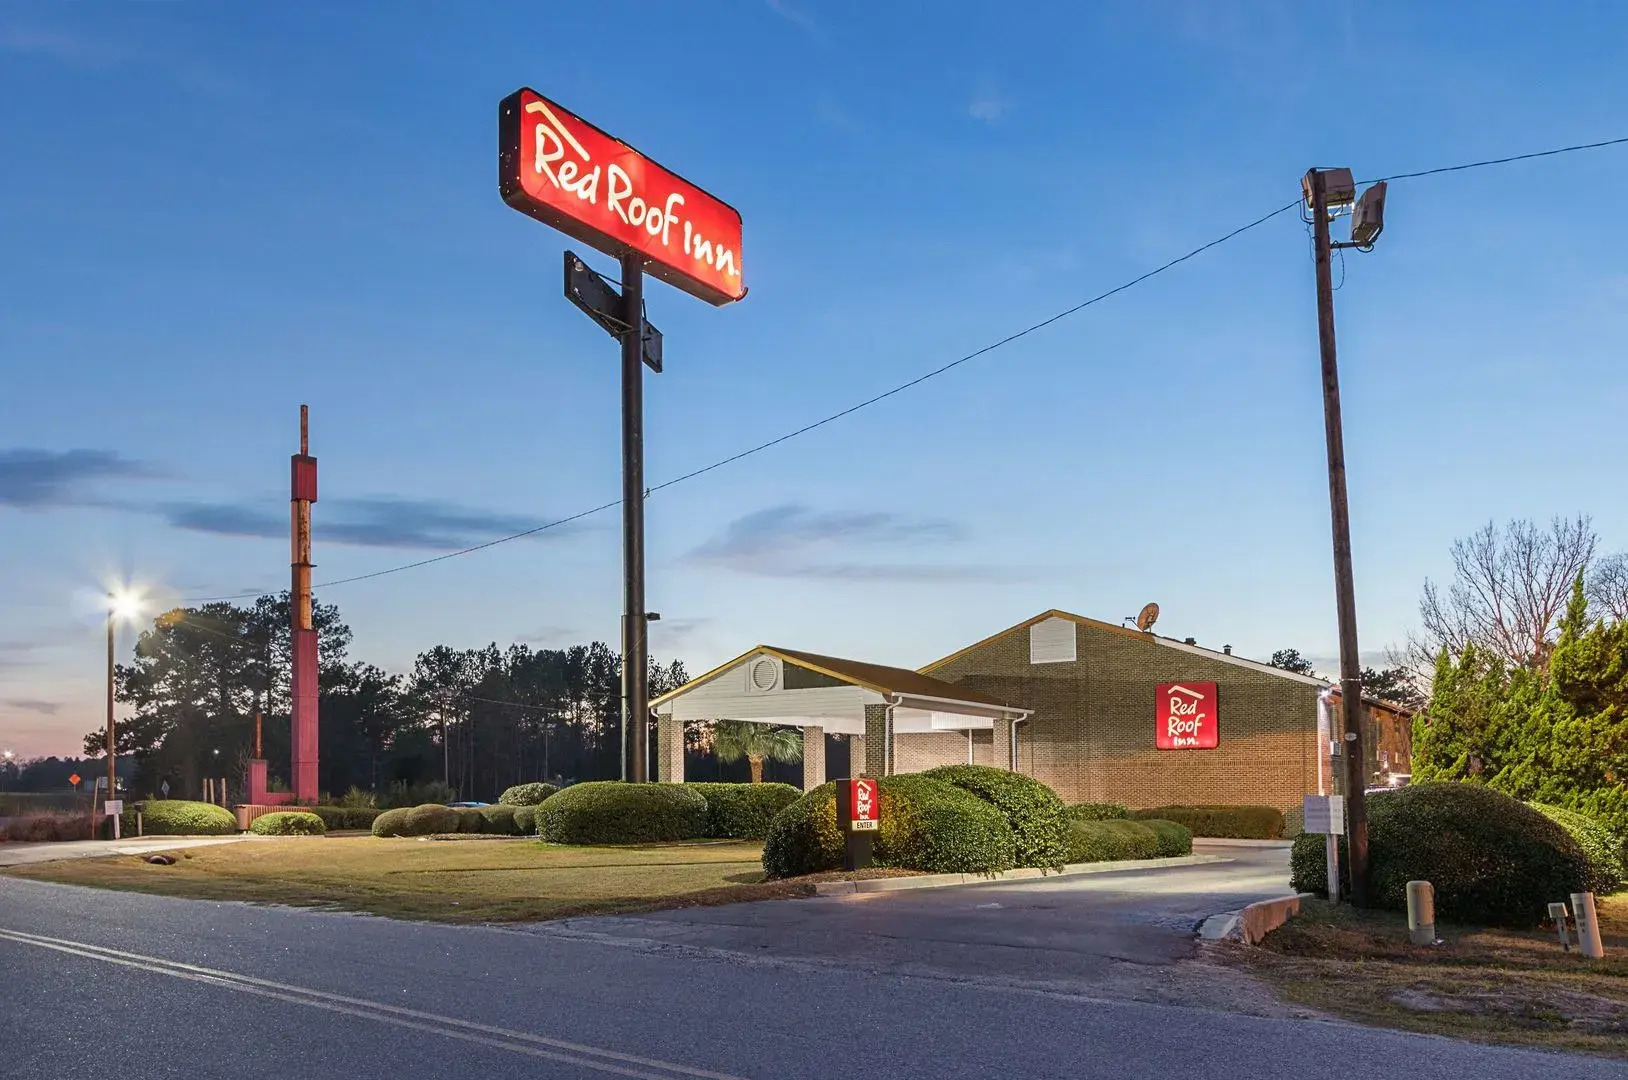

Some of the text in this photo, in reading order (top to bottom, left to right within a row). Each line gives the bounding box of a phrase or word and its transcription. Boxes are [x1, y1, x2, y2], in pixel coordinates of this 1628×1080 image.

[535, 123, 601, 204] Red
[608, 164, 685, 245] Roof
[1170, 697, 1197, 716] Red
[1168, 713, 1206, 737] Roof
[856, 821, 873, 829] ENTER
